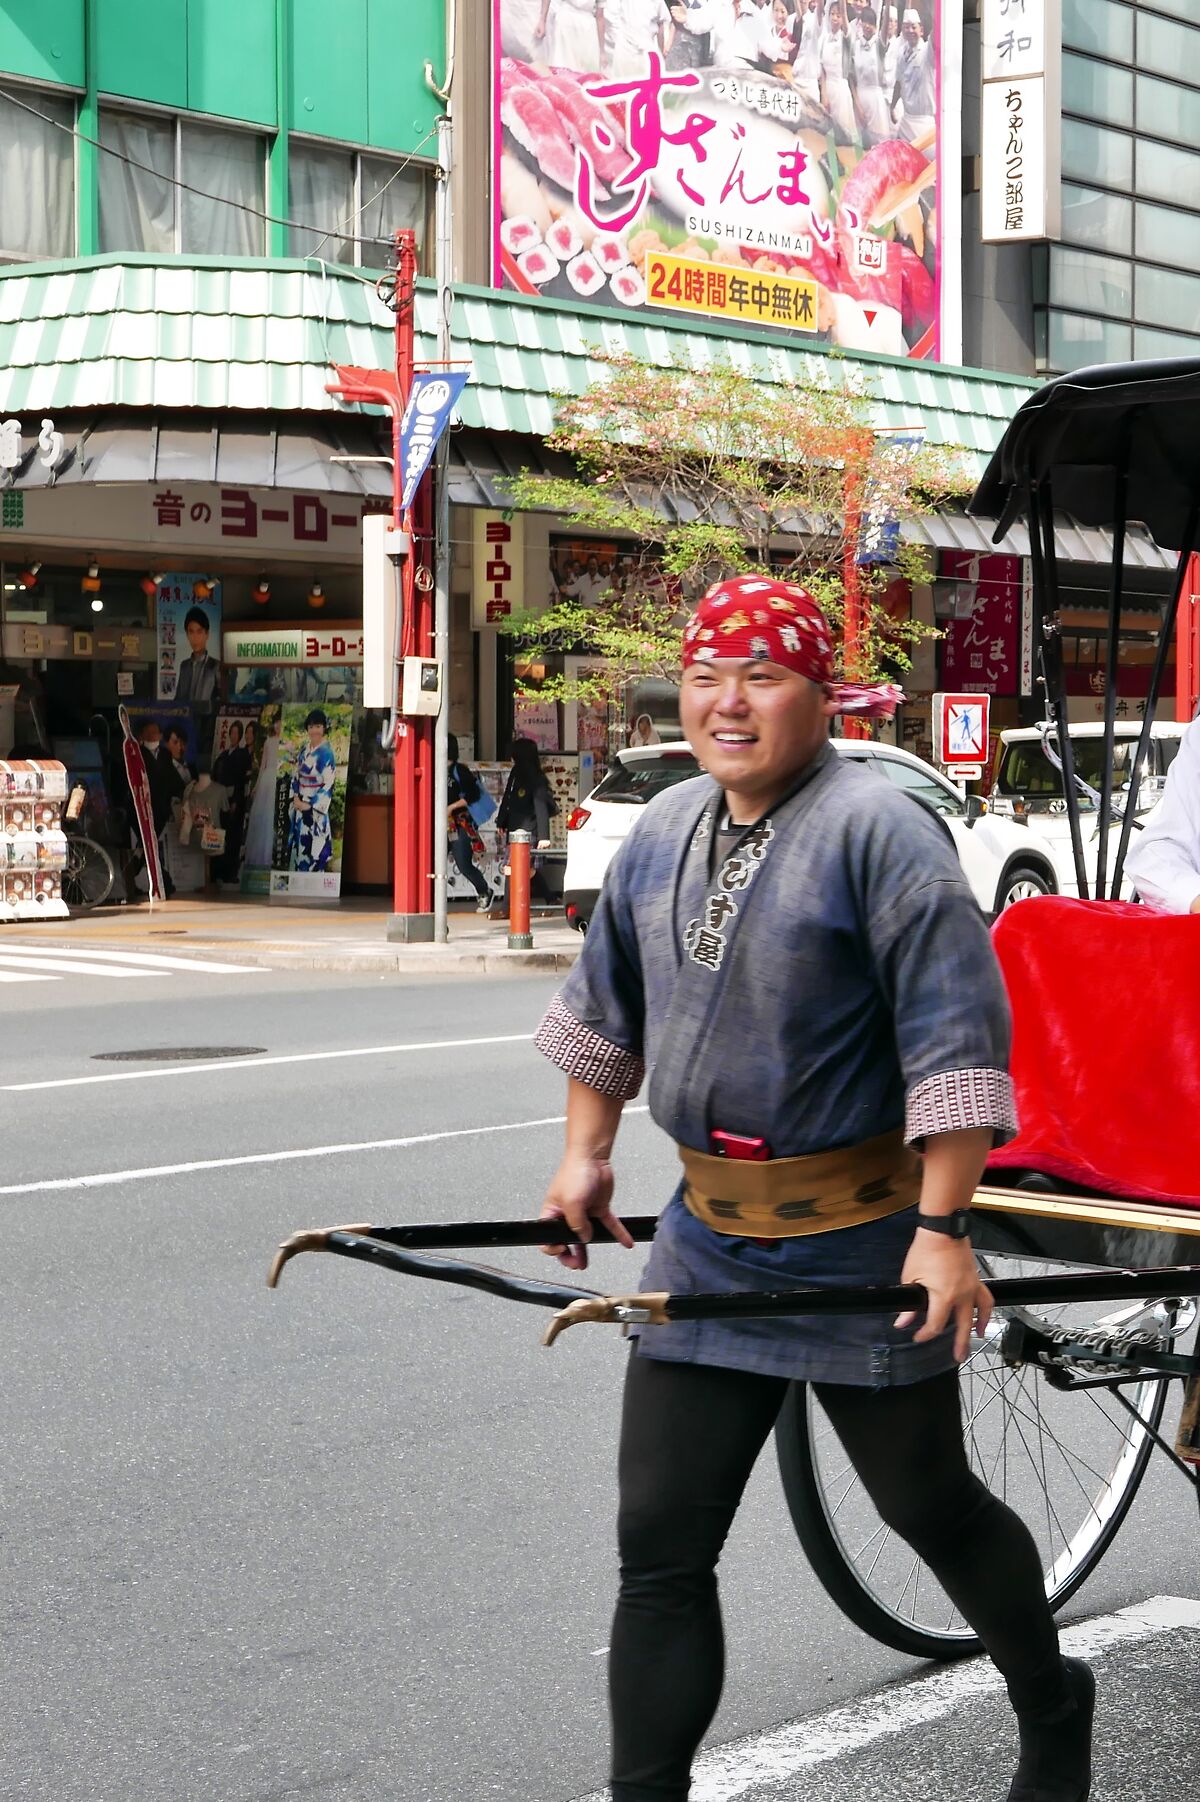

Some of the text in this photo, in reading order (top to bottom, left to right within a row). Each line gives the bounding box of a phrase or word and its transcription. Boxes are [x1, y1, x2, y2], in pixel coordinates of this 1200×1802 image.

[576, 51, 859, 242] すしざんまい
[713, 80, 799, 117] つきじ喜代村
[1003, 88, 1026, 232] ちゃんこ部屋
[689, 215, 811, 254] SUSHIZANMAI
[650, 261, 815, 324] 24時間年中無休
[237, 642, 298, 658] INFORMATION
[956, 552, 1009, 681] すざんまい
[682, 818, 776, 972] えびす屋
